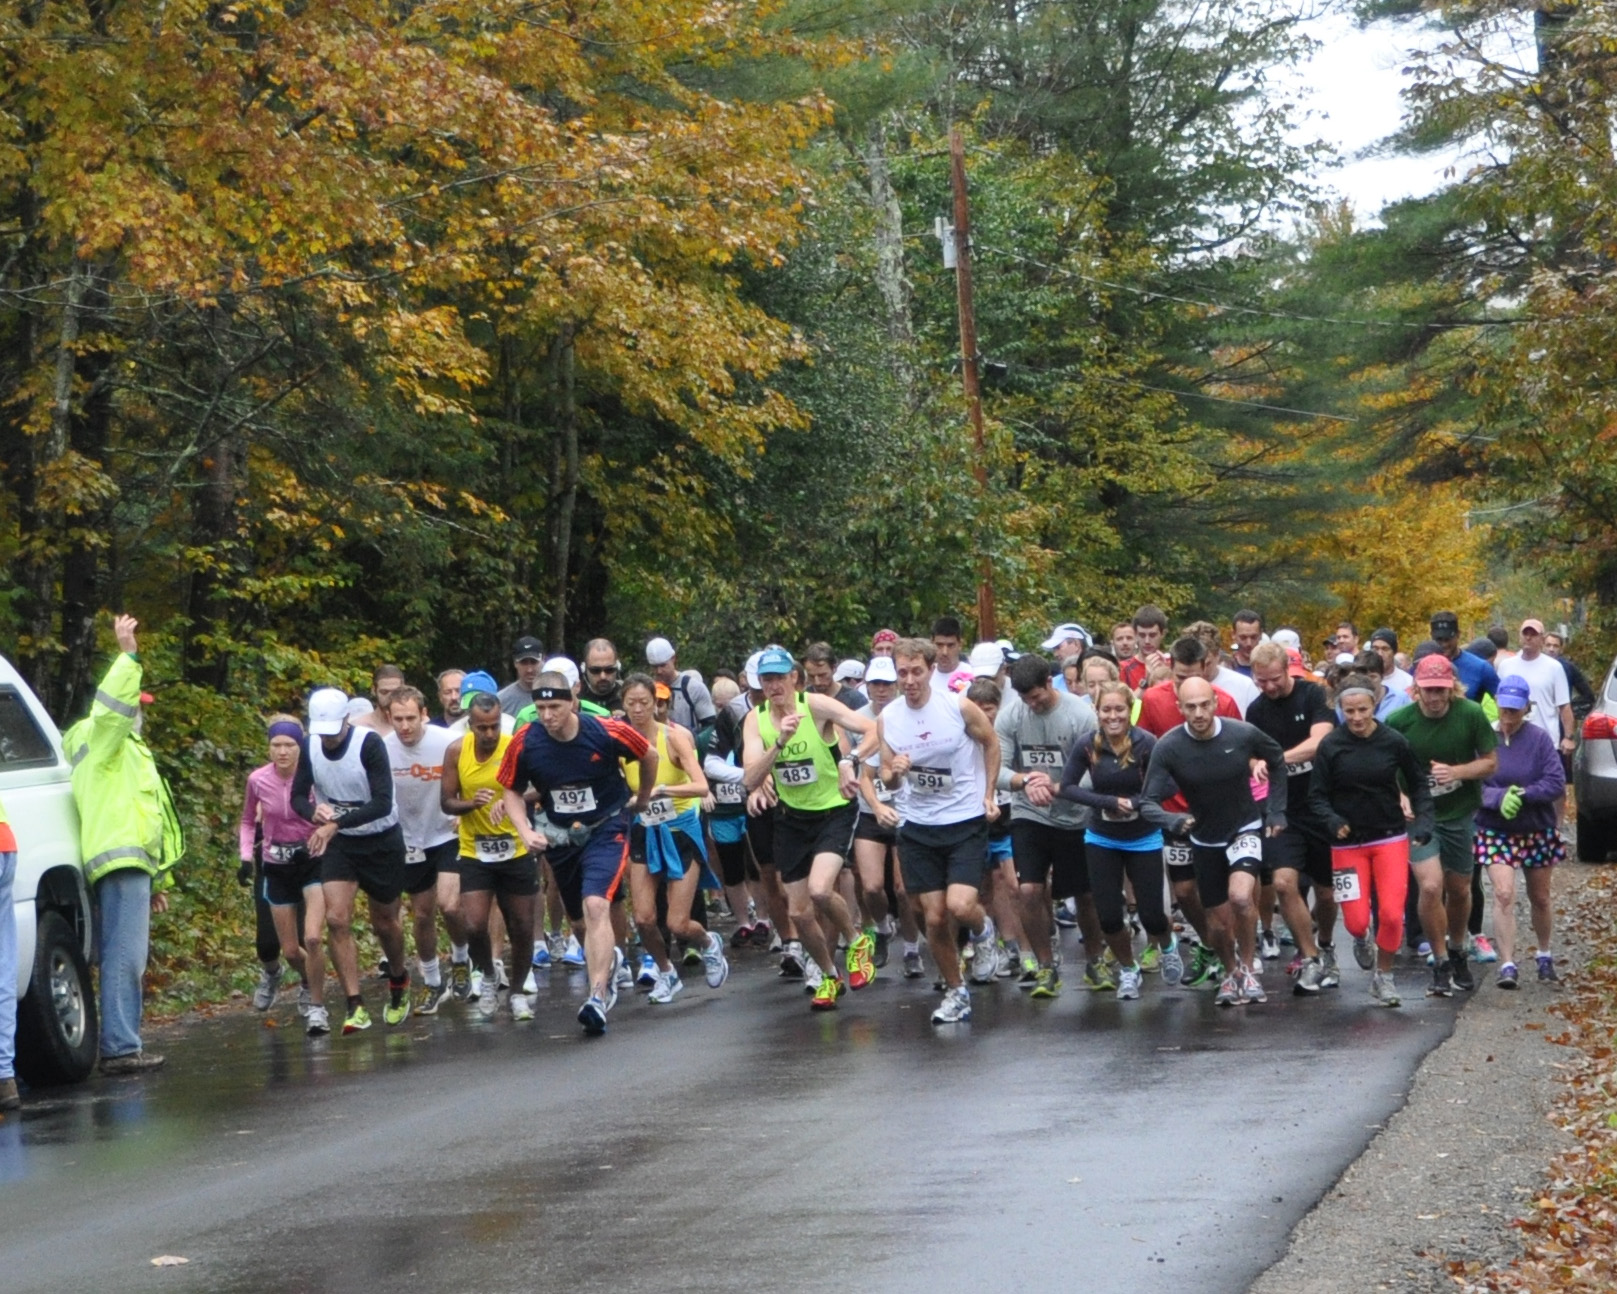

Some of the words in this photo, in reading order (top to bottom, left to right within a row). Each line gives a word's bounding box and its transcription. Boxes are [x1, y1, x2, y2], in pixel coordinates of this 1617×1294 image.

[1030, 752, 1055, 764] 573
[783, 767, 811, 782] 483
[918, 773, 944, 788] 591
[559, 790, 587, 804] 497
[481, 841, 509, 853] 549
[1232, 837, 1257, 854] 565
